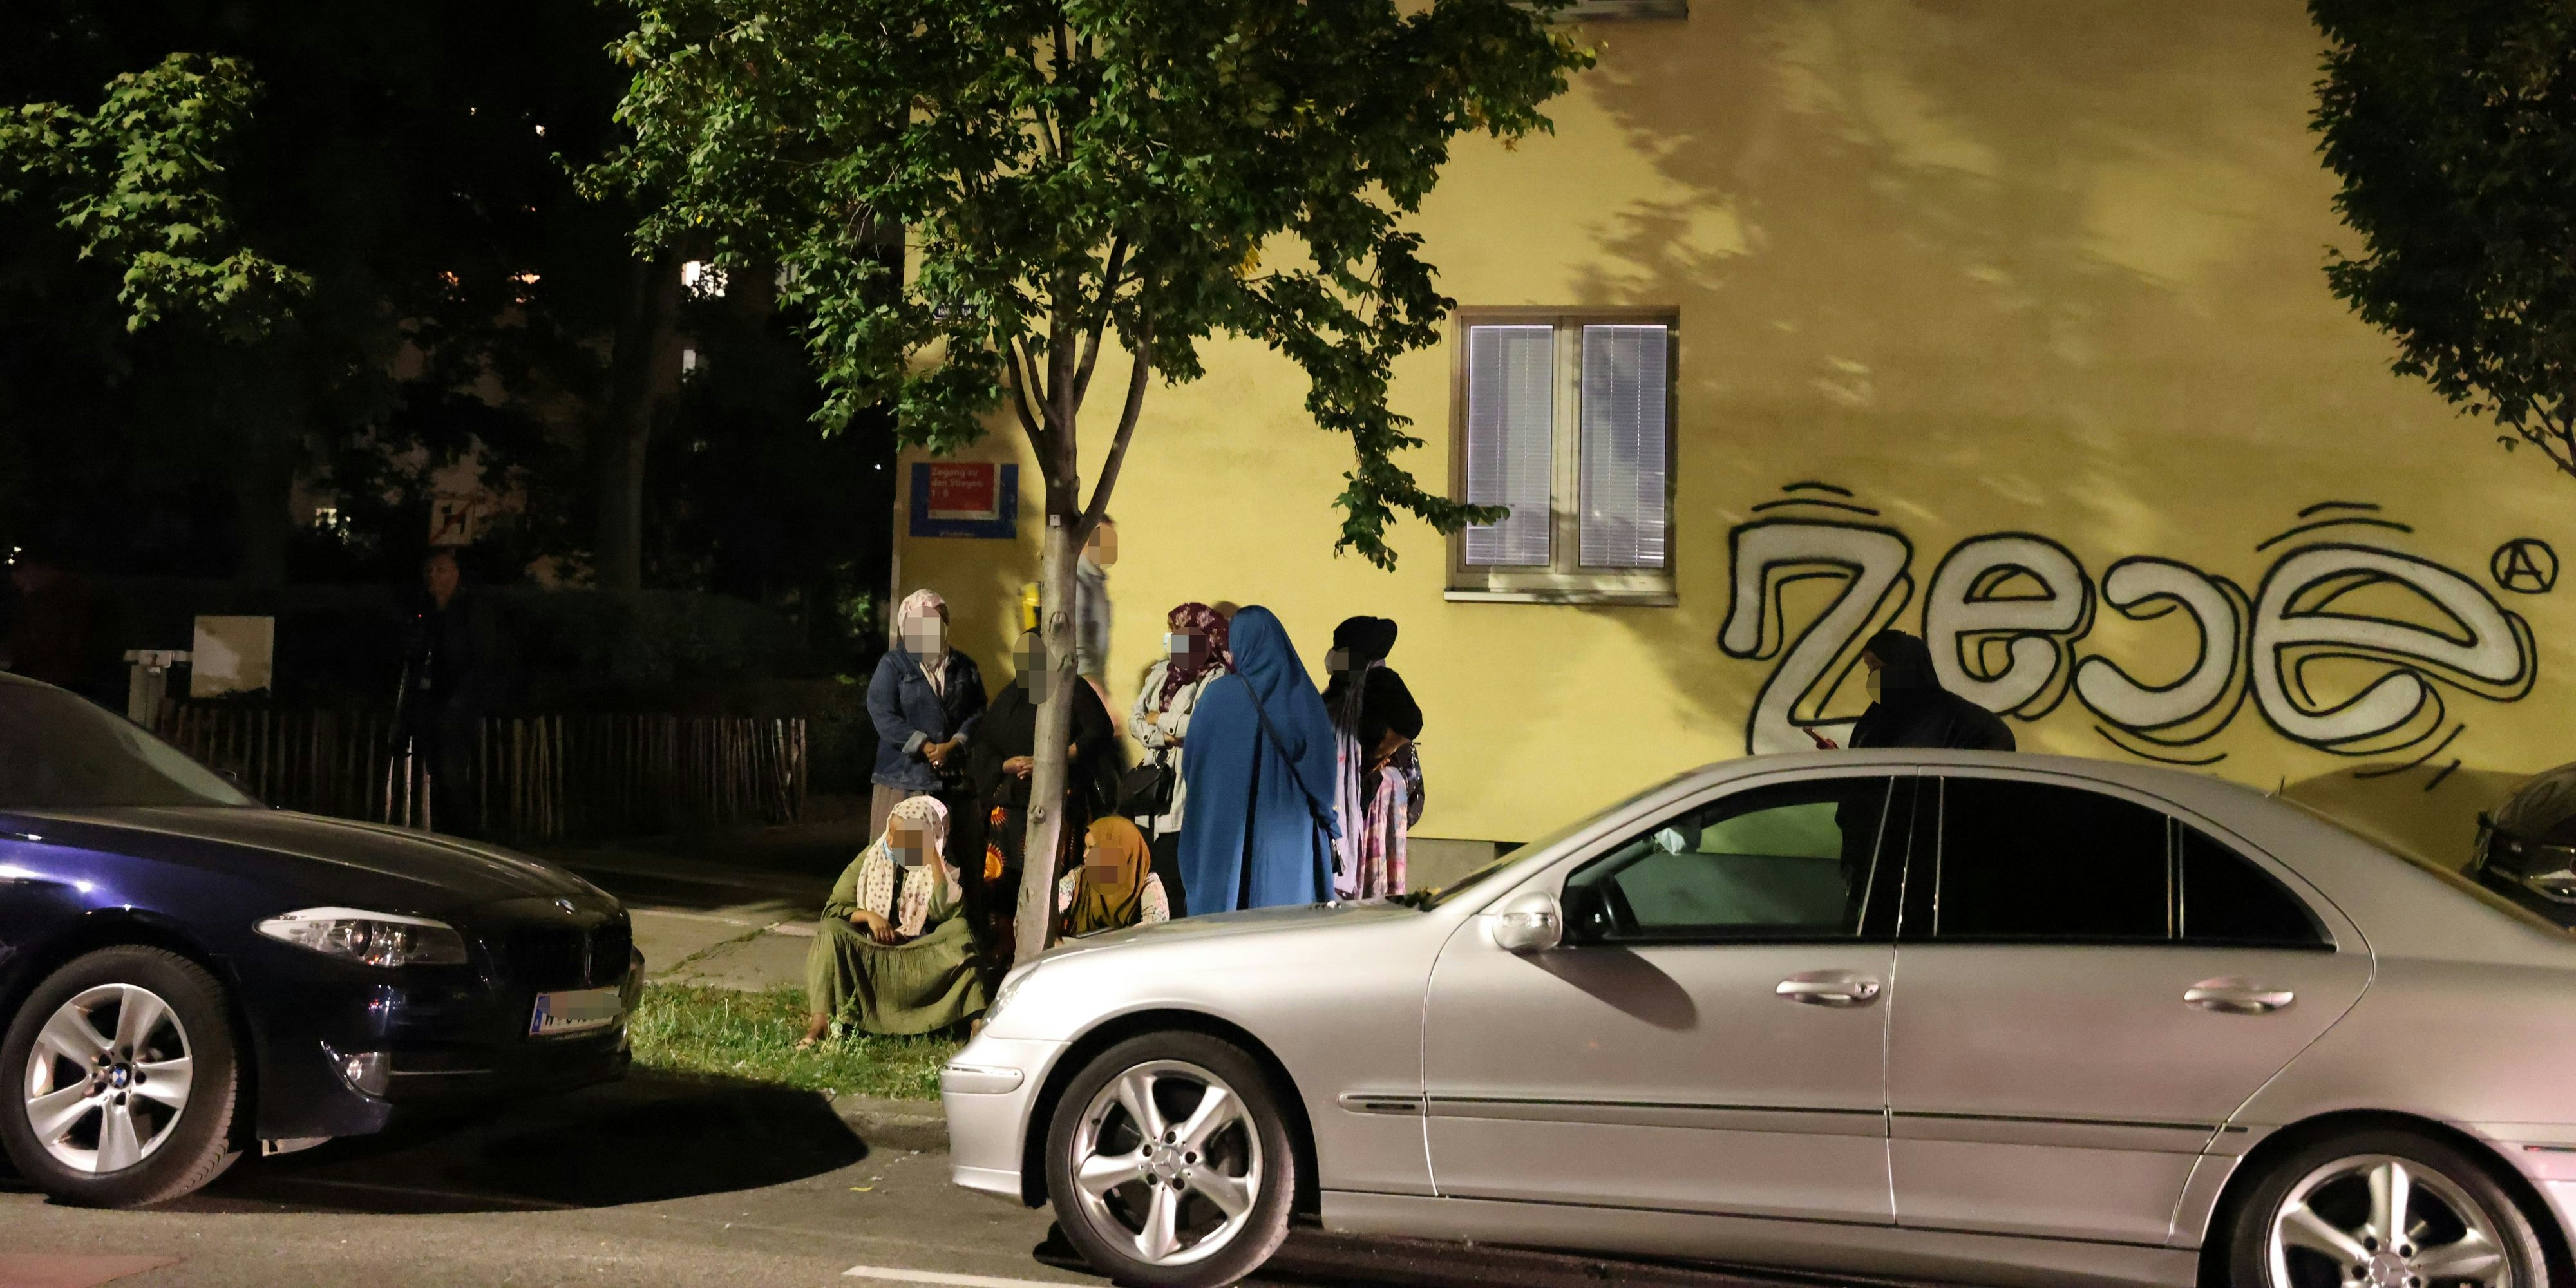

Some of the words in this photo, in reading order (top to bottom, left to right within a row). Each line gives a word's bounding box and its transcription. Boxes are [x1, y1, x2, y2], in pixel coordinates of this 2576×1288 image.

[931, 467, 966, 478] Zugang
[931, 478, 948, 487] den
[949, 478, 983, 489] Stiegen
